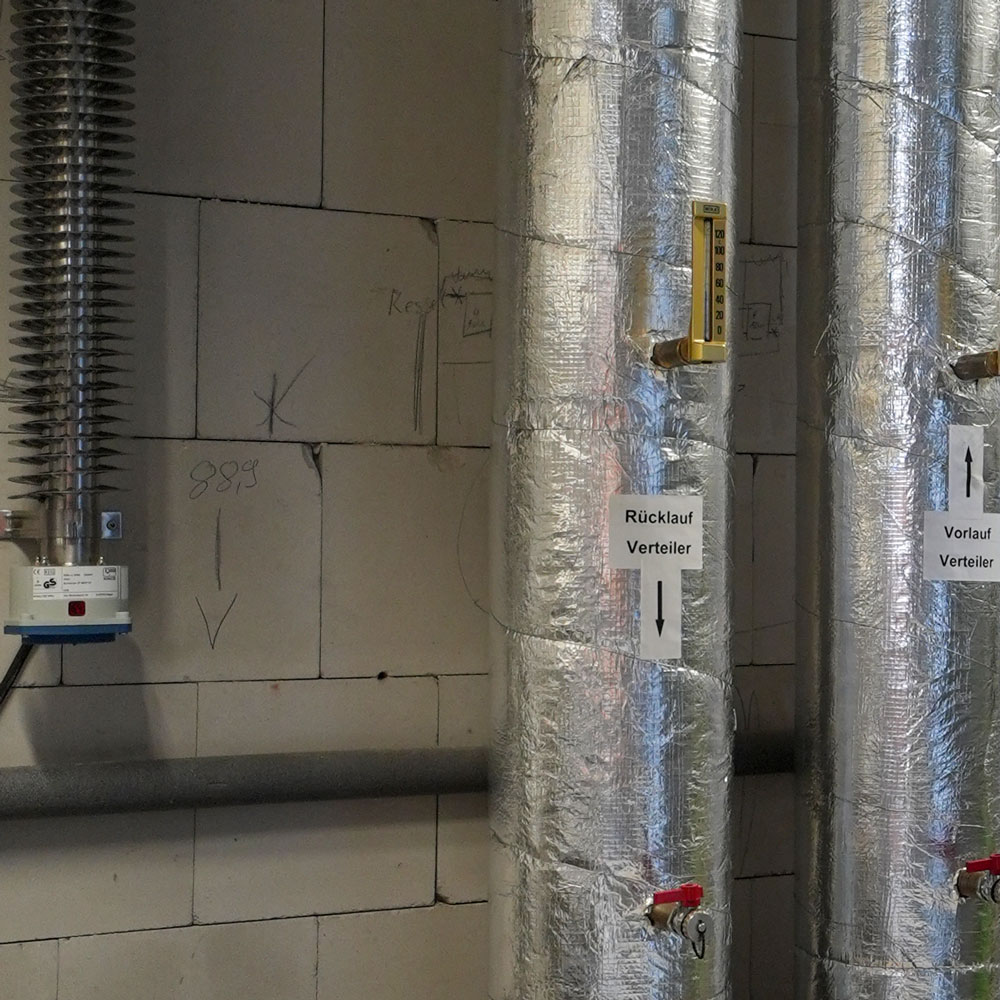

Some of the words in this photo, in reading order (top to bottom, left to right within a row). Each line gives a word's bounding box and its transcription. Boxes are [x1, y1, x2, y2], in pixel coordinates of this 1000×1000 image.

[715, 229, 725, 239] 120
[715, 246, 725, 255] 100
[715, 262, 724, 272] 80
[715, 278, 724, 288] 60
[715, 295, 724, 304] 40
[715, 310, 724, 320] 20
[717, 325, 722, 335] 0
[625, 509, 694, 525] Rücklauf
[944, 525, 992, 540] Vorlauf
[626, 540, 692, 555] Verteiler
[939, 554, 994, 568] Verteiler
